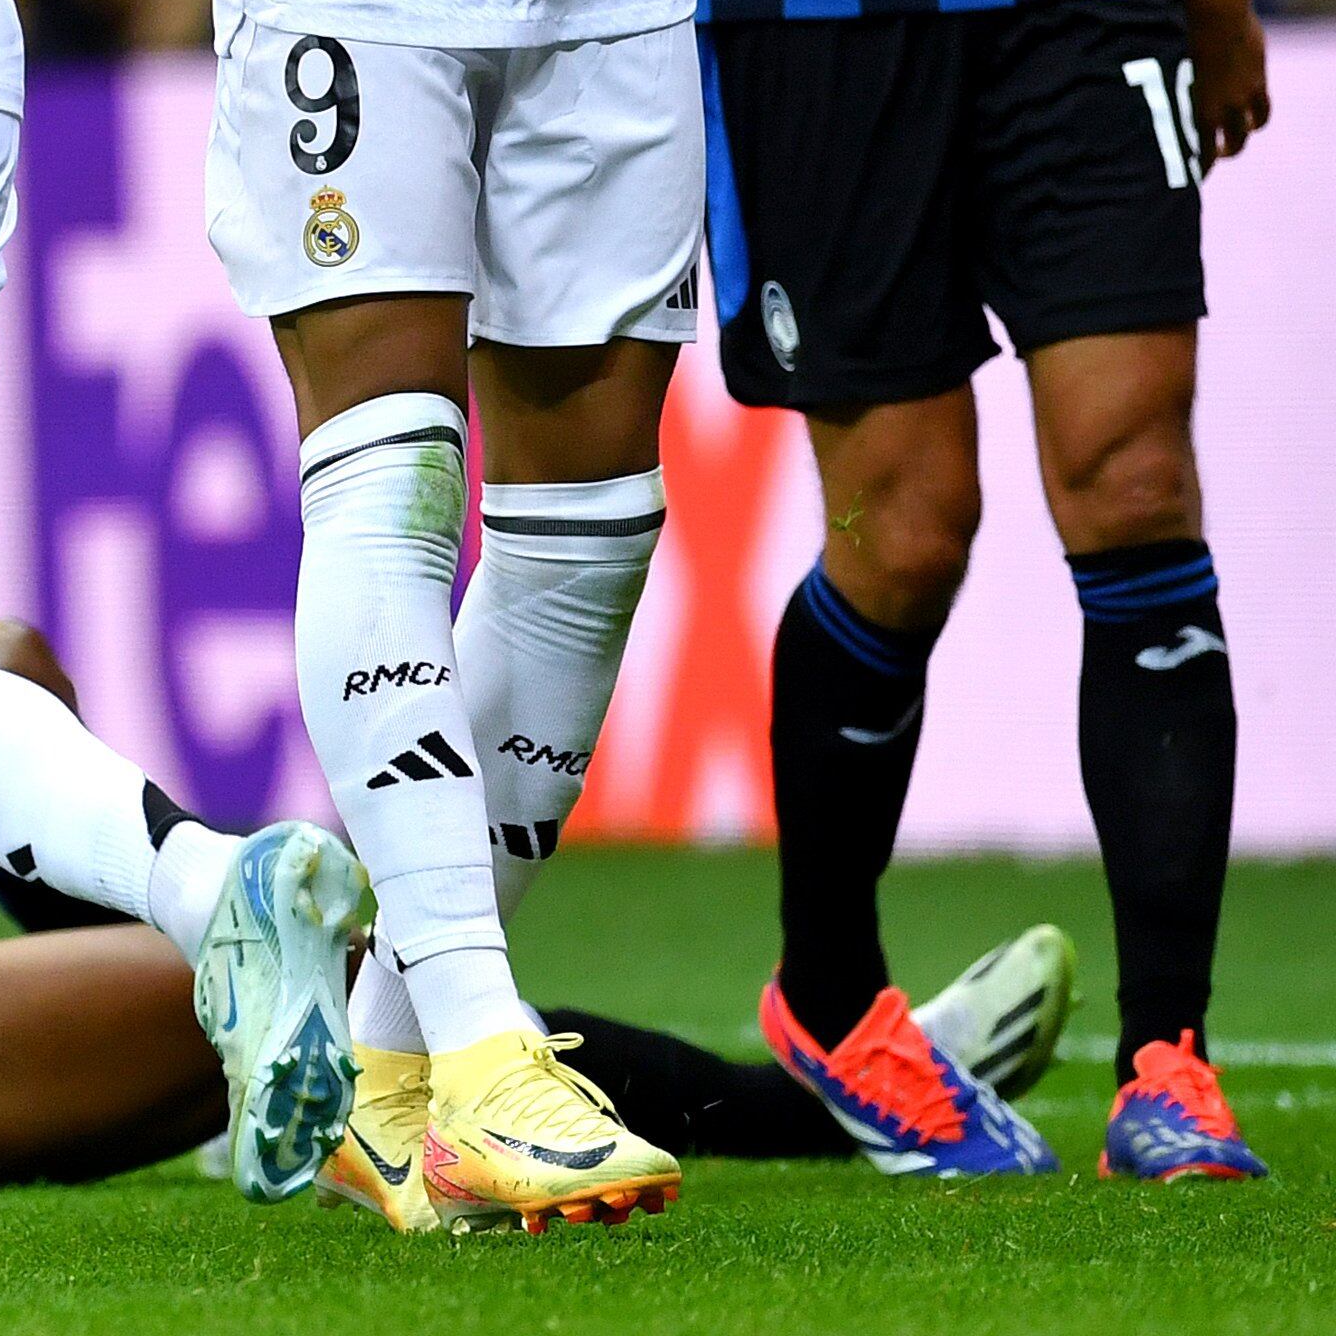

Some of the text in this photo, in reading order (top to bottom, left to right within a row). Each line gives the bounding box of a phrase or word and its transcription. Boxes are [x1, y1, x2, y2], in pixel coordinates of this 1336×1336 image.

[284, 34, 361, 176] 9
[342, 661, 451, 702] RMCF
[497, 734, 592, 776] RMC
